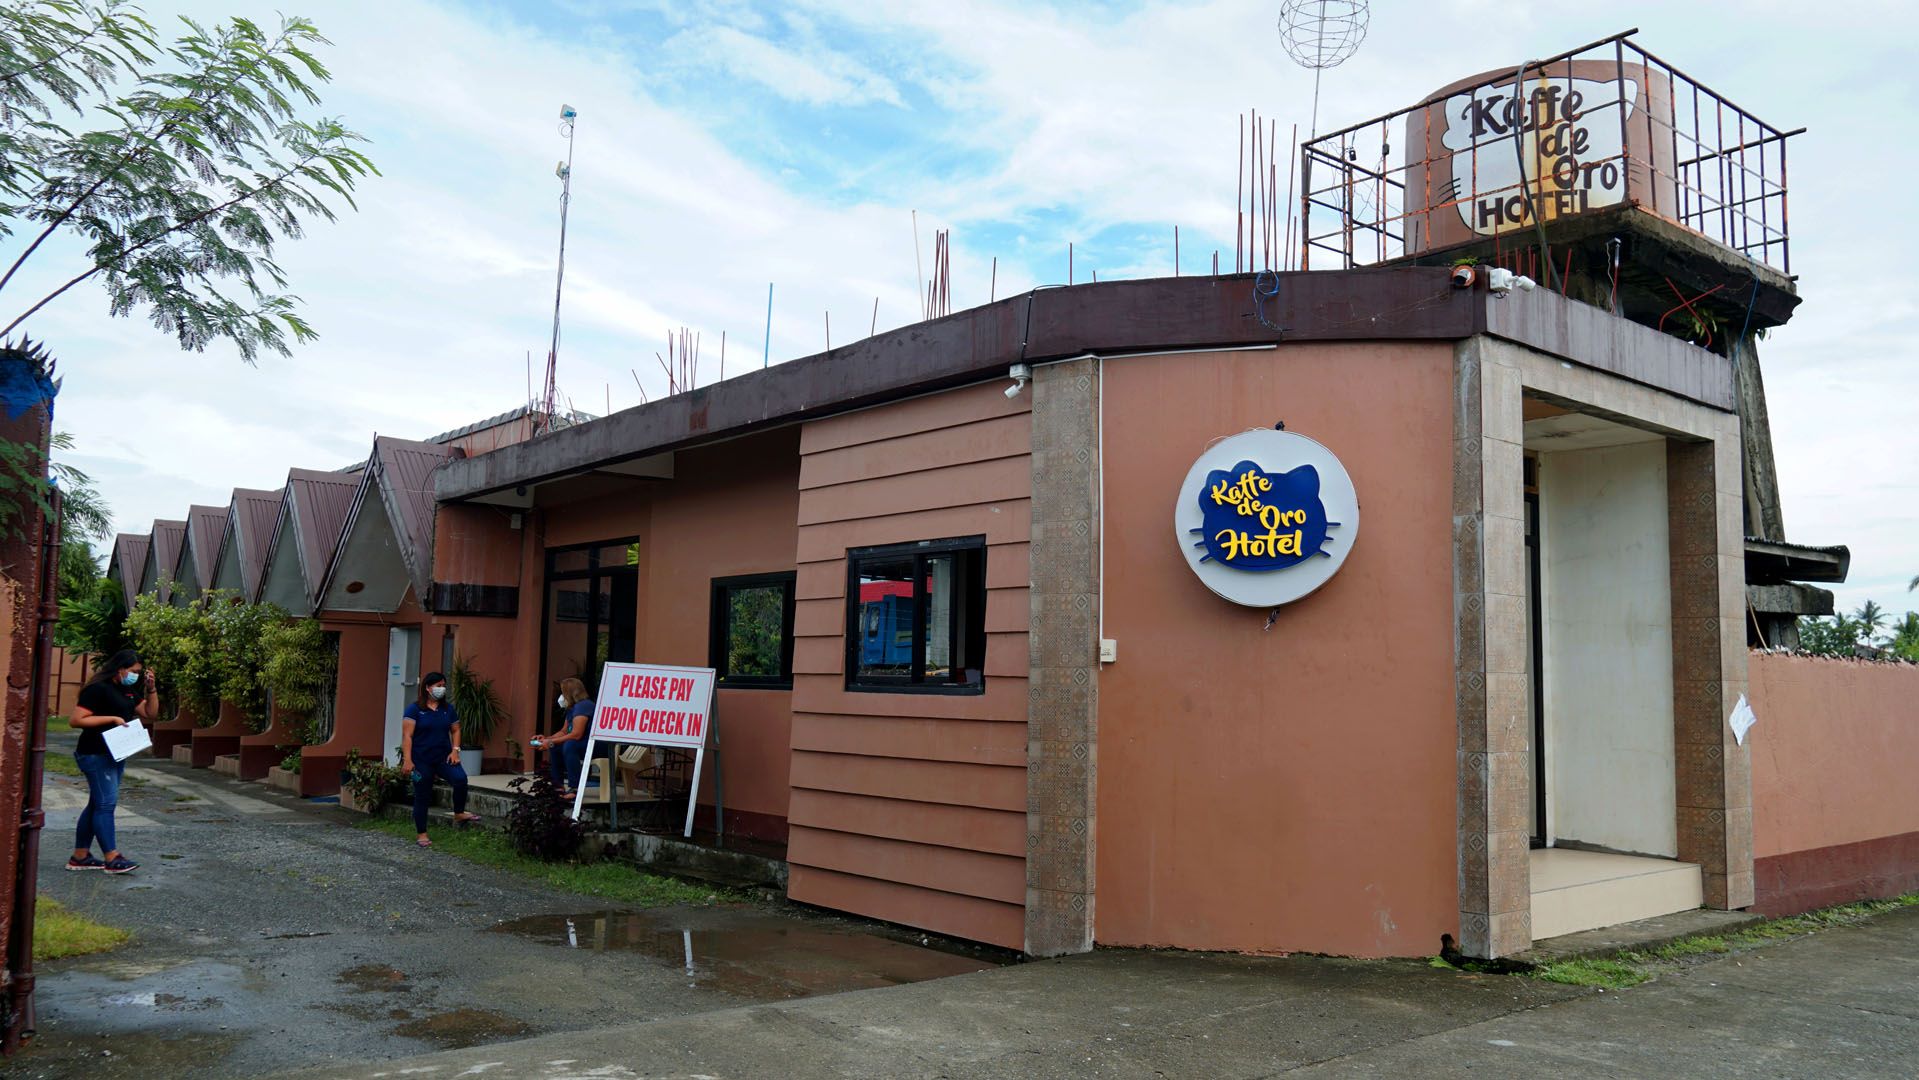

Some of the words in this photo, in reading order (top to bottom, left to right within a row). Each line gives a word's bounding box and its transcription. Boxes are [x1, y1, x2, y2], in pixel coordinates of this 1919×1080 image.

[1461, 85, 1583, 138] Kaffe
[1541, 123, 1589, 158] de
[1552, 155, 1618, 190] Oro
[1210, 469, 1273, 506] Kaffe
[1237, 497, 1265, 516] de
[1259, 505, 1307, 531] Oro
[1215, 529, 1303, 560] Hotel
[619, 674, 667, 700] PLEASE
[668, 677, 695, 702] PAY
[599, 706, 638, 732] UPON
[638, 709, 686, 736] CHECK
[686, 713, 703, 737] IN
